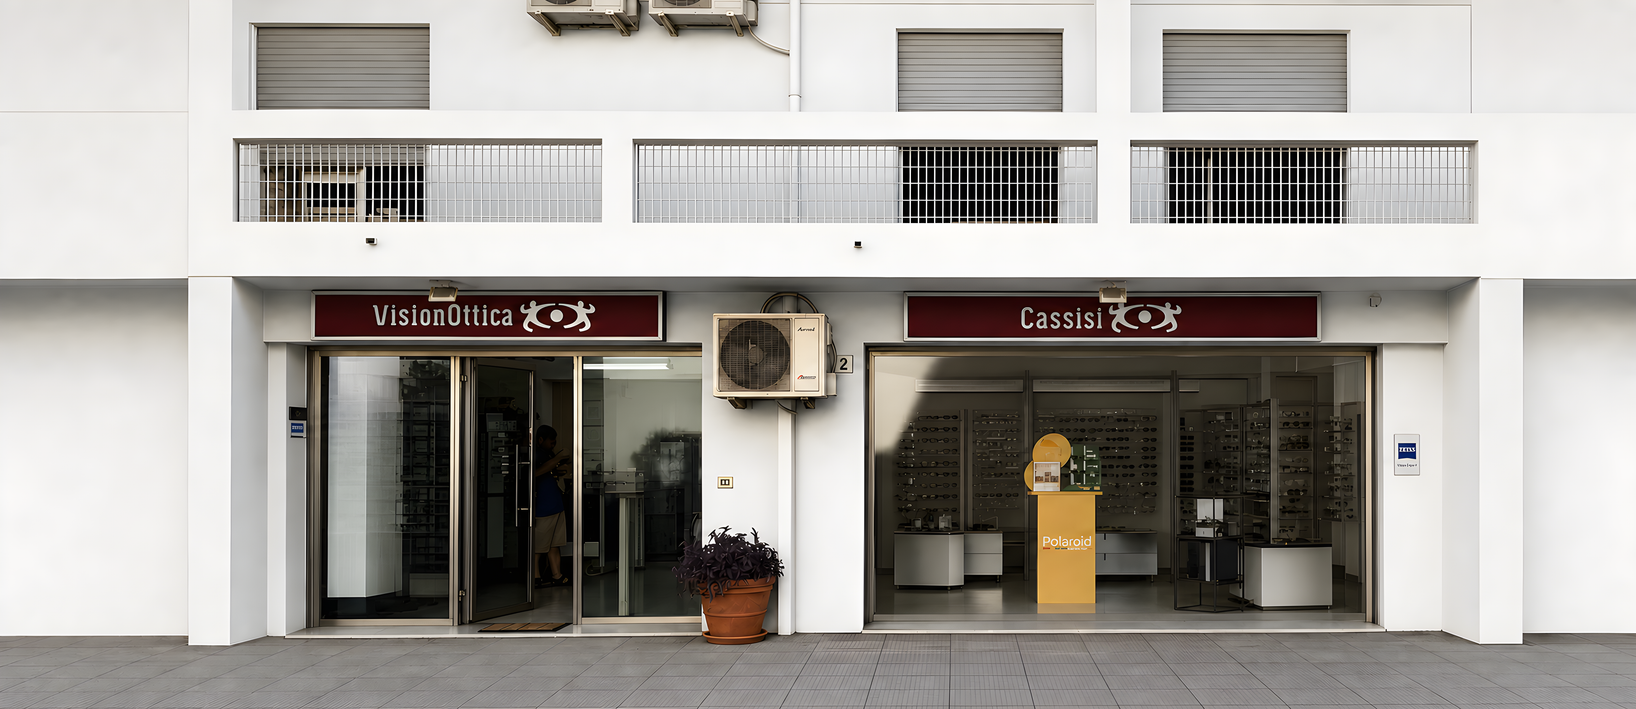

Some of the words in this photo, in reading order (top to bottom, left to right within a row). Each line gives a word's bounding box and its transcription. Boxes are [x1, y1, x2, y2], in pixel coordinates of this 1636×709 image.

[373, 304, 513, 326] VisionOttica
[1021, 307, 1102, 329] Cassisi
[839, 358, 848, 370] 2
[1042, 535, 1092, 547] Polaroid
